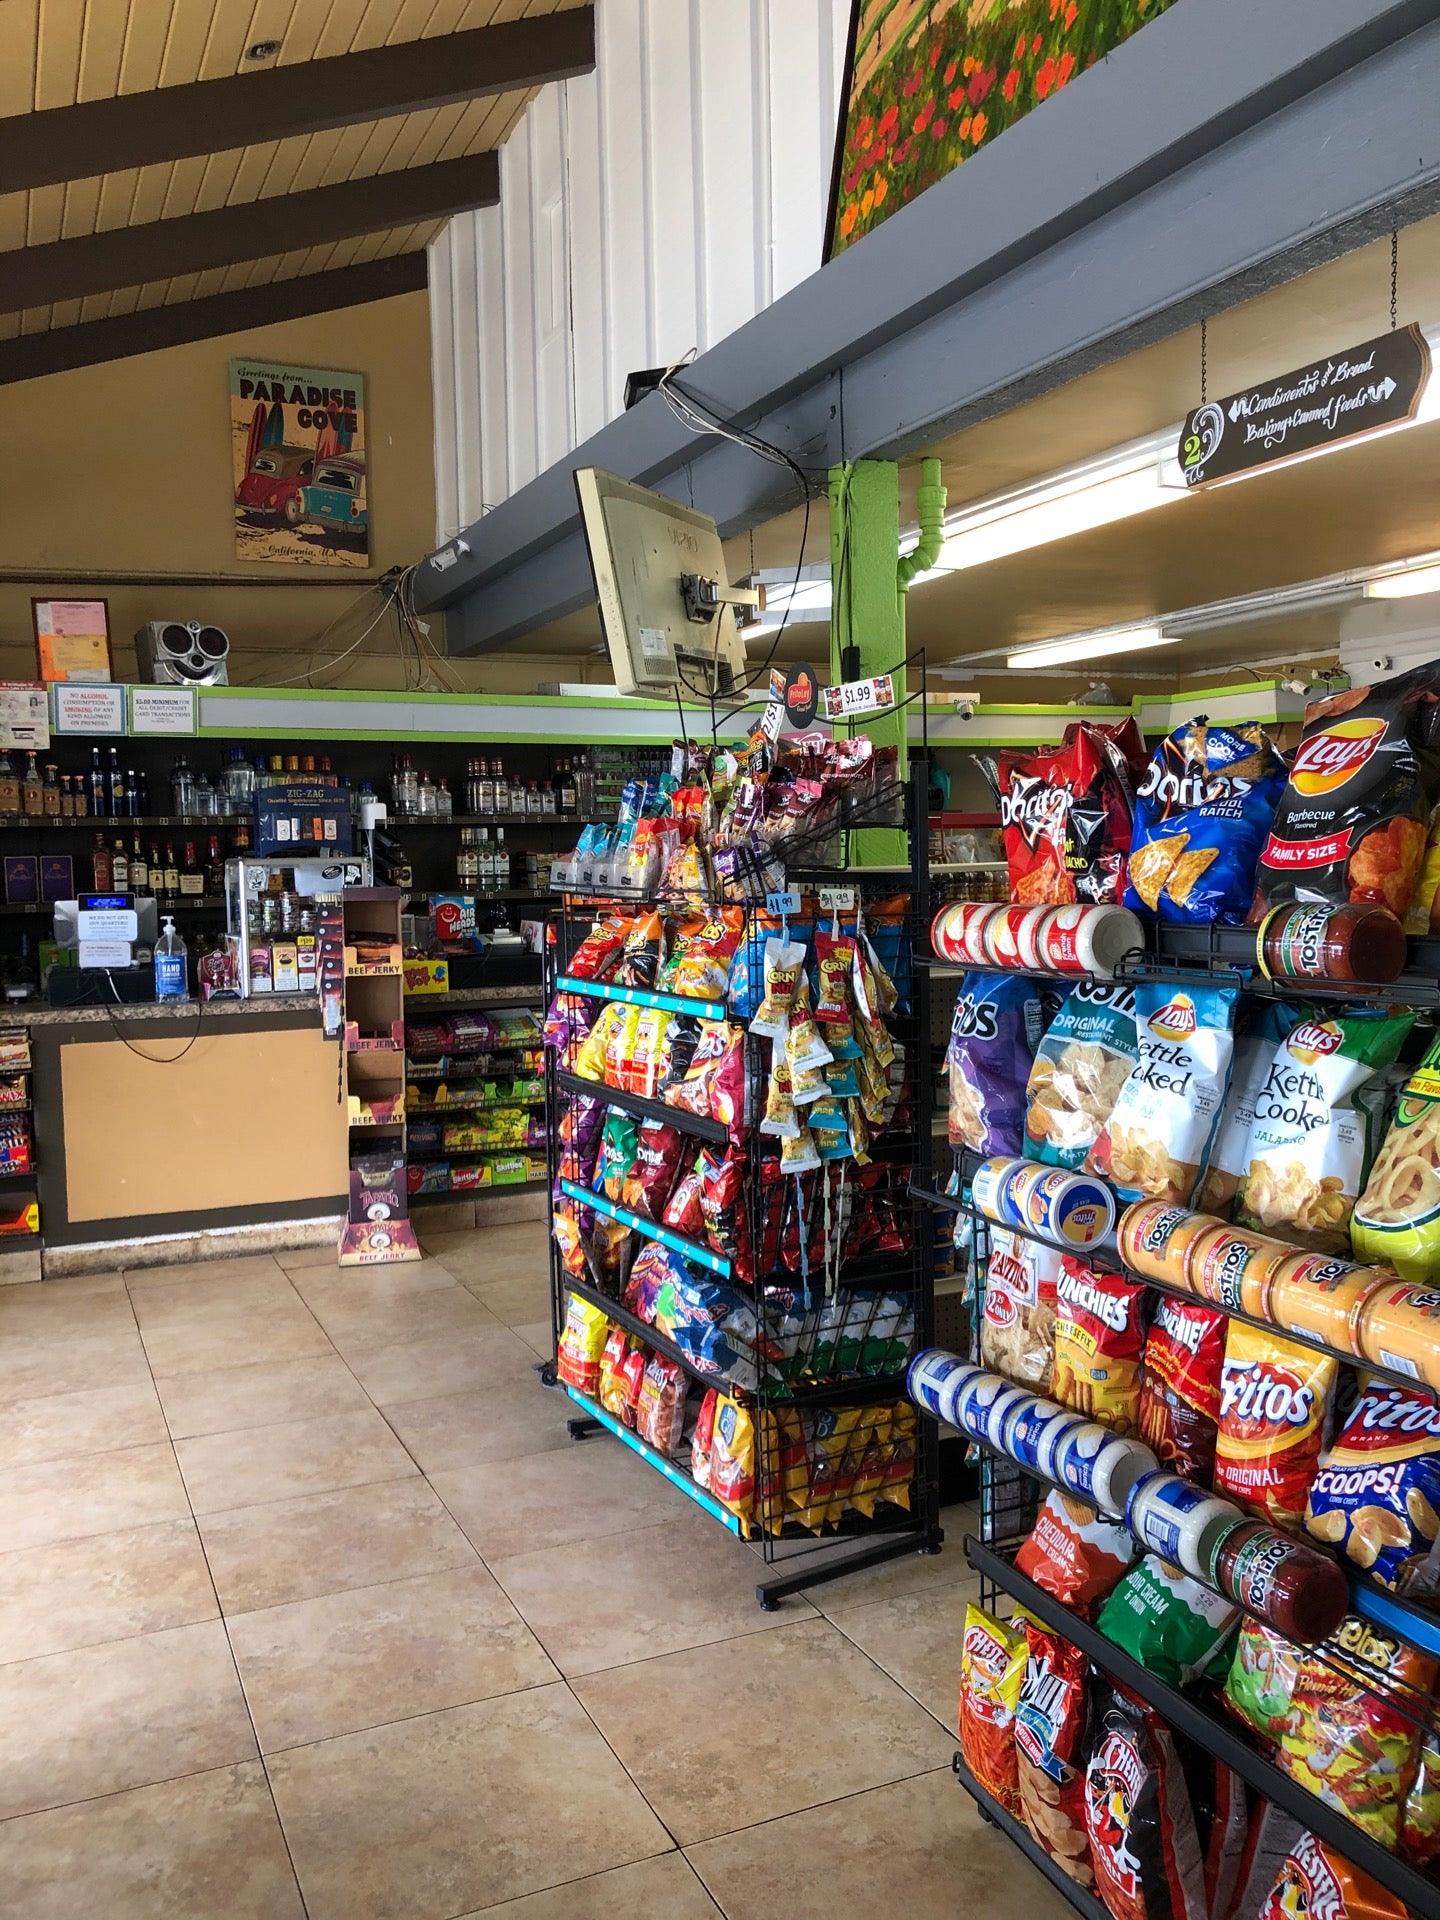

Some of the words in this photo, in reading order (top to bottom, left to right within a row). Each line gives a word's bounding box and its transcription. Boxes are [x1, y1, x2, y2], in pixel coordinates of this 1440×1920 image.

[238, 368, 280, 380] Greetings
[1248, 372, 1319, 416] Condiments
[1331, 351, 1376, 385] Bread
[240, 379, 356, 410] PARADISE
[297, 408, 357, 433] COVE
[1184, 436, 1201, 465] 2
[844, 686, 871, 705] $1.99
[763, 703, 778, 734] 2/$1
[1208, 737, 1236, 760] COOL
[1220, 732, 1246, 752] MORE
[1293, 734, 1379, 777] Lay's
[287, 790, 324, 798] ZIG-ZAG
[1137, 763, 1252, 806] Doritos
[1002, 784, 1074, 826] Doritos
[1199, 807, 1243, 818] RANCH
[1212, 800, 1243, 809] OOL
[1287, 809, 1335, 824] Barbecue
[1269, 846, 1305, 861] FAMILY
[1308, 843, 1338, 859] SIZE
[460, 908, 475, 920] AIR
[450, 918, 475, 933] HEADS
[1299, 904, 1337, 971] TOSTITO
[162, 964, 180, 972] HAND
[348, 967, 369, 975] BEEF
[372, 966, 400, 974] JERKY
[767, 967, 796, 984] CORN
[821, 959, 848, 973] CORN
[772, 983, 794, 994] NUT
[1053, 1014, 1115, 1033] ORIGINAL
[1152, 1006, 1195, 1031] Lay's
[496, 1162, 523, 1172] Skittles
[452, 1174, 479, 1183] Skittles
[360, 1253, 377, 1261] BEEF
[381, 1252, 404, 1260] JERKY
[1222, 1241, 1248, 1310] OSTITOS
[1219, 1358, 1314, 1427] Fritos
[1345, 1384, 1440, 1438] ritos
[1030, 1422, 1043, 1446] Ranch
[1230, 1423, 1263, 1433] BRAND
[1350, 1434, 1389, 1442] BRAND
[1081, 1463, 1090, 1490] Ranch
[1226, 1466, 1284, 1487] ORIGINAL
[1311, 1464, 1406, 1495] SCOOPS!
[1238, 1486, 1252, 1496] CHIPS
[1329, 1496, 1342, 1504] CORN
[1343, 1497, 1359, 1505] CHIPS
[1036, 1516, 1075, 1559] CHEDDAR
[1037, 1534, 1048, 1553] SOUR
[1046, 1548, 1067, 1568] CREAM
[1126, 1571, 1145, 1592] SOUR
[1141, 1583, 1169, 1615] CREAM
[1129, 1595, 1147, 1616] ONION
